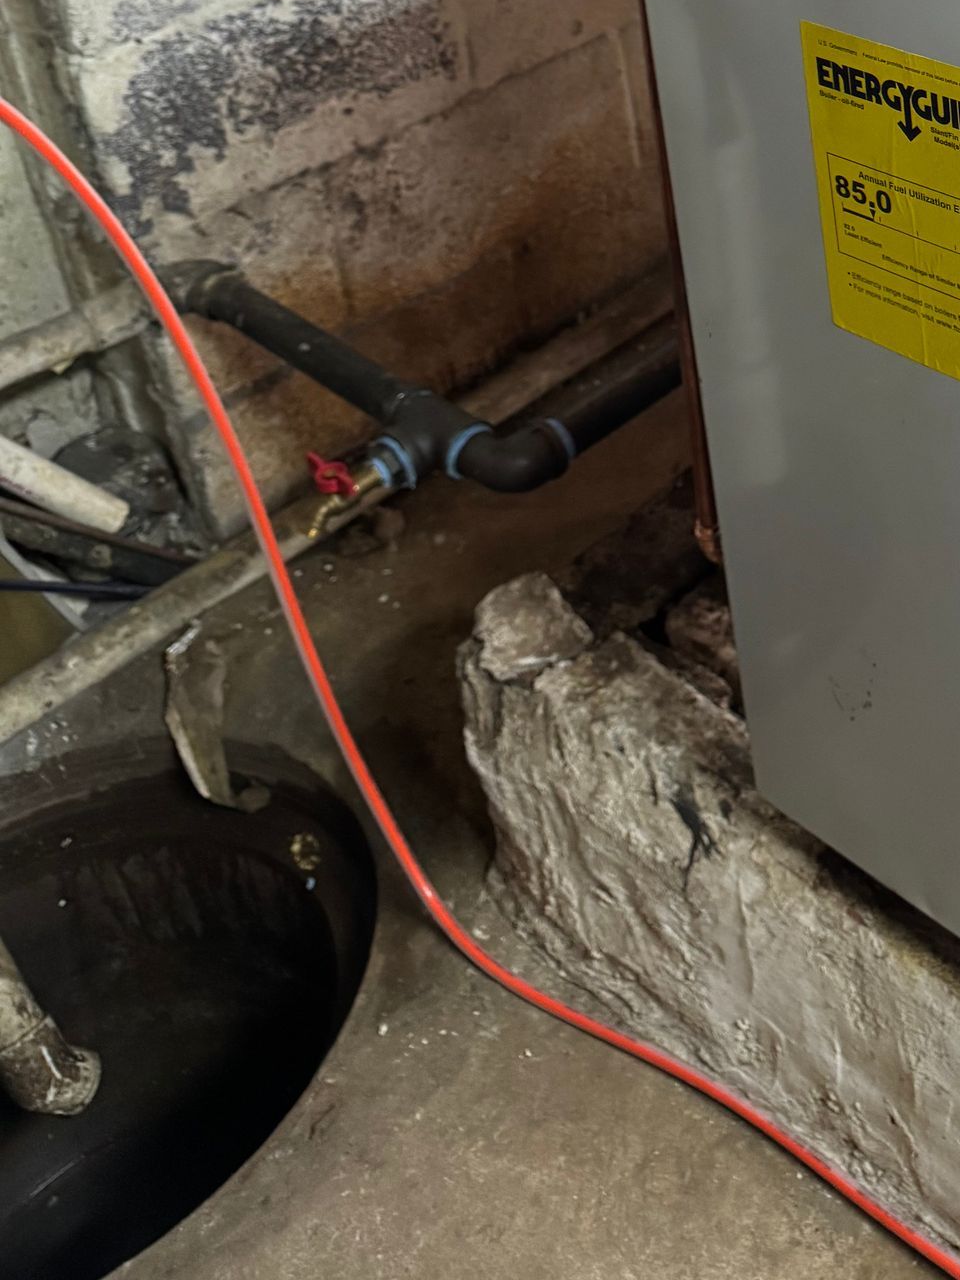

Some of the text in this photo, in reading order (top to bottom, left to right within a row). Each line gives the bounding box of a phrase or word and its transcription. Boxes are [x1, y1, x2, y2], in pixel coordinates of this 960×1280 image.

[835, 175, 892, 214] 85.0
[859, 171, 887, 188] Annual
[889, 181, 907, 195] Fuel
[908, 189, 952, 211] Utilization
